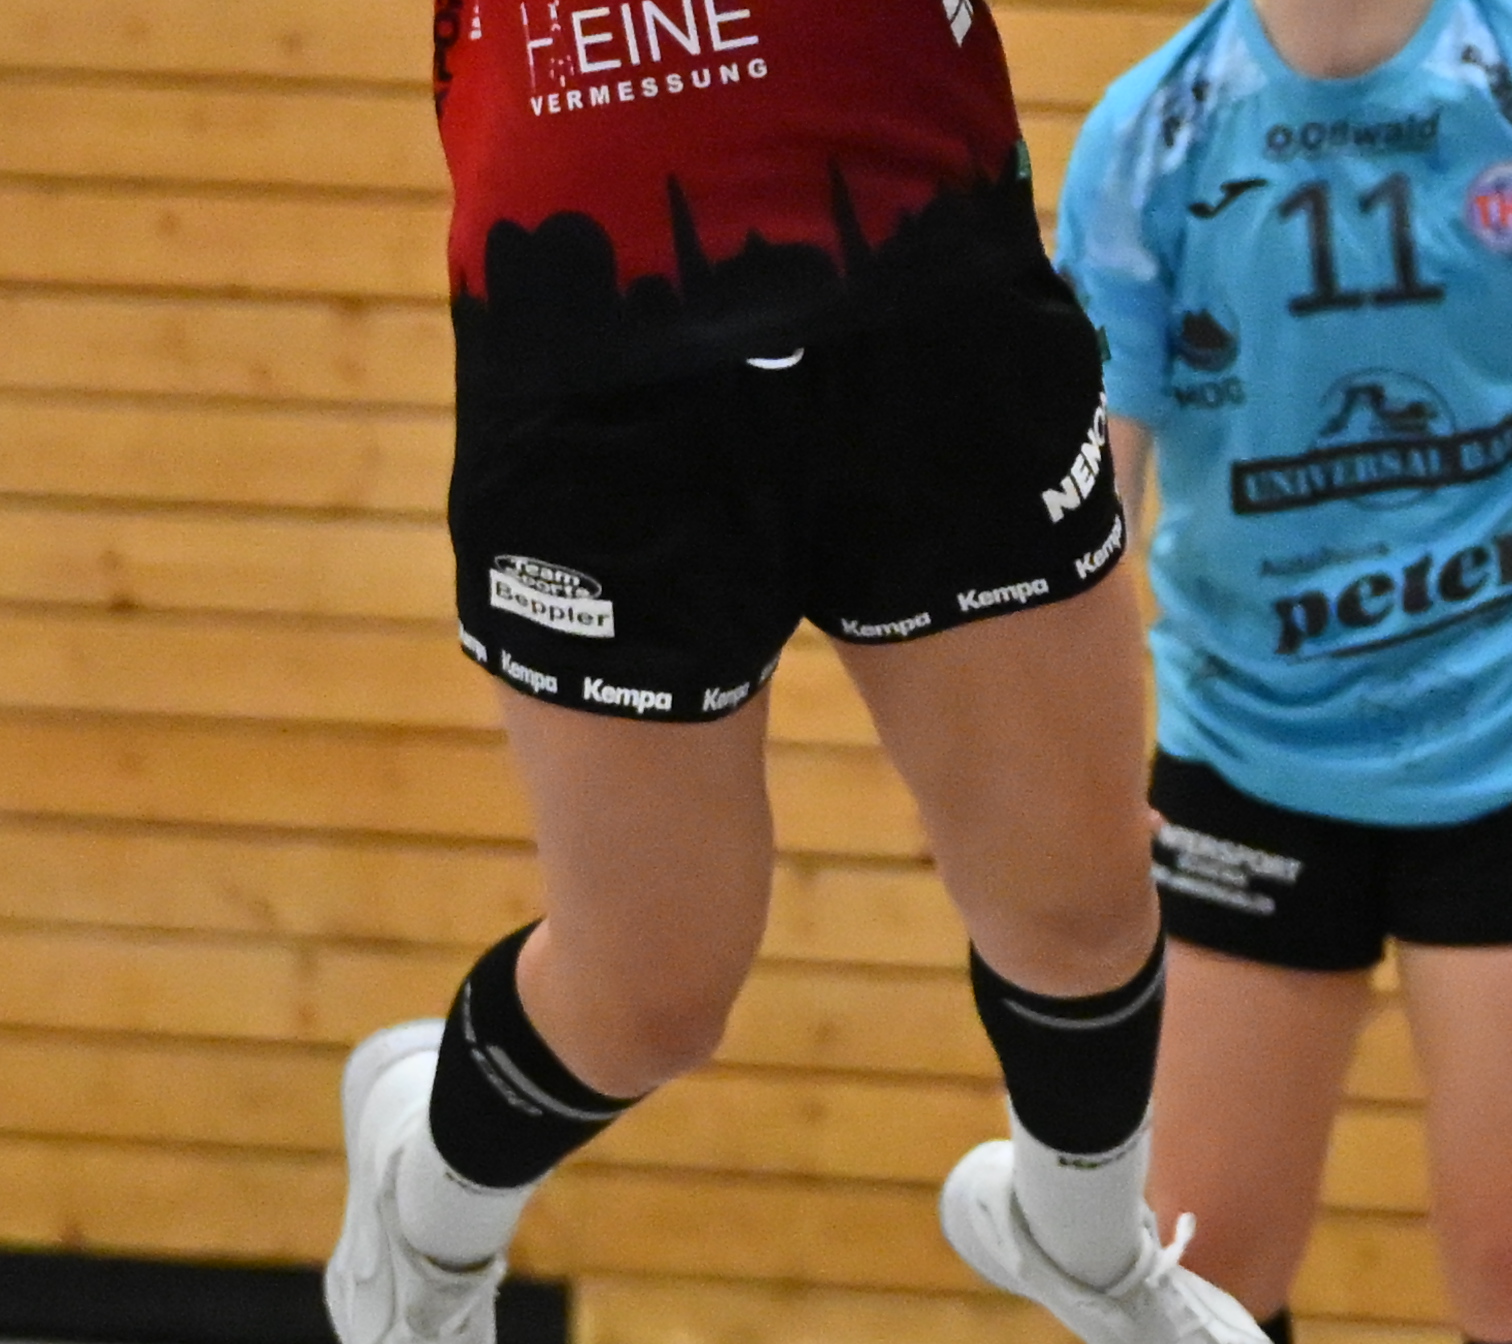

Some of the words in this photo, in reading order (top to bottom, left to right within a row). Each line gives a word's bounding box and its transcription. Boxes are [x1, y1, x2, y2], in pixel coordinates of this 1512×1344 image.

[529, 56, 769, 117] VERMESSUNG
[1277, 171, 1445, 316] 11
[510, 557, 581, 587] Team
[495, 580, 610, 628] Beppler
[956, 577, 1050, 612] Kempa
[840, 611, 932, 638] Kempa
[501, 649, 559, 697] Kempa
[583, 676, 673, 715] Kempa
